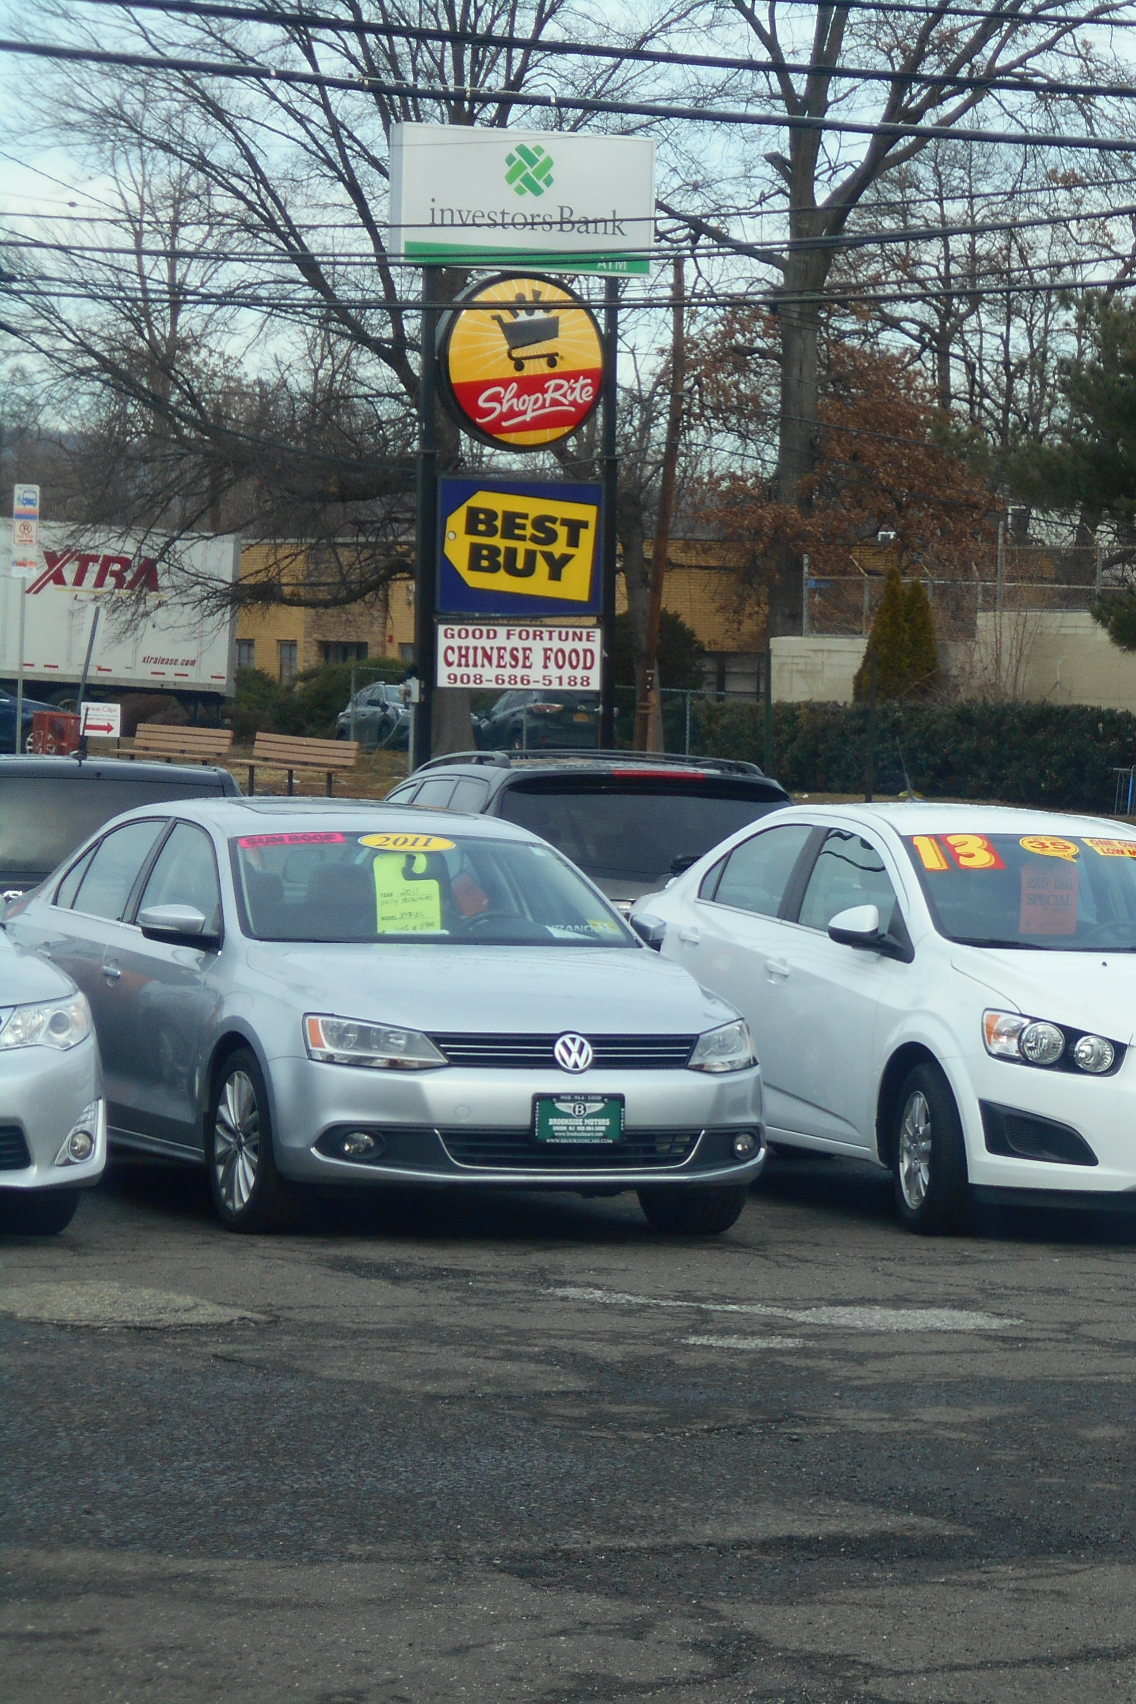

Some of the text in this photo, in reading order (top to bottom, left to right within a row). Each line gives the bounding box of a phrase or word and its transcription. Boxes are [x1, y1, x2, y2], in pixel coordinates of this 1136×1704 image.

[475, 375, 594, 424] ShopRite
[464, 505, 589, 548] BEST
[25, 549, 159, 594] XTRA
[467, 541, 575, 582] BUY
[443, 627, 596, 643] GOOD FORTUNE
[141, 655, 197, 667] xtralease.com
[443, 645, 595, 671] CHINESE FOOD
[446, 672, 591, 688] 908-686-5188
[375, 836, 433, 848] 2011
[912, 834, 1005, 871] 13
[1027, 840, 1072, 850] 35
[1101, 847, 1125, 855] LOW
